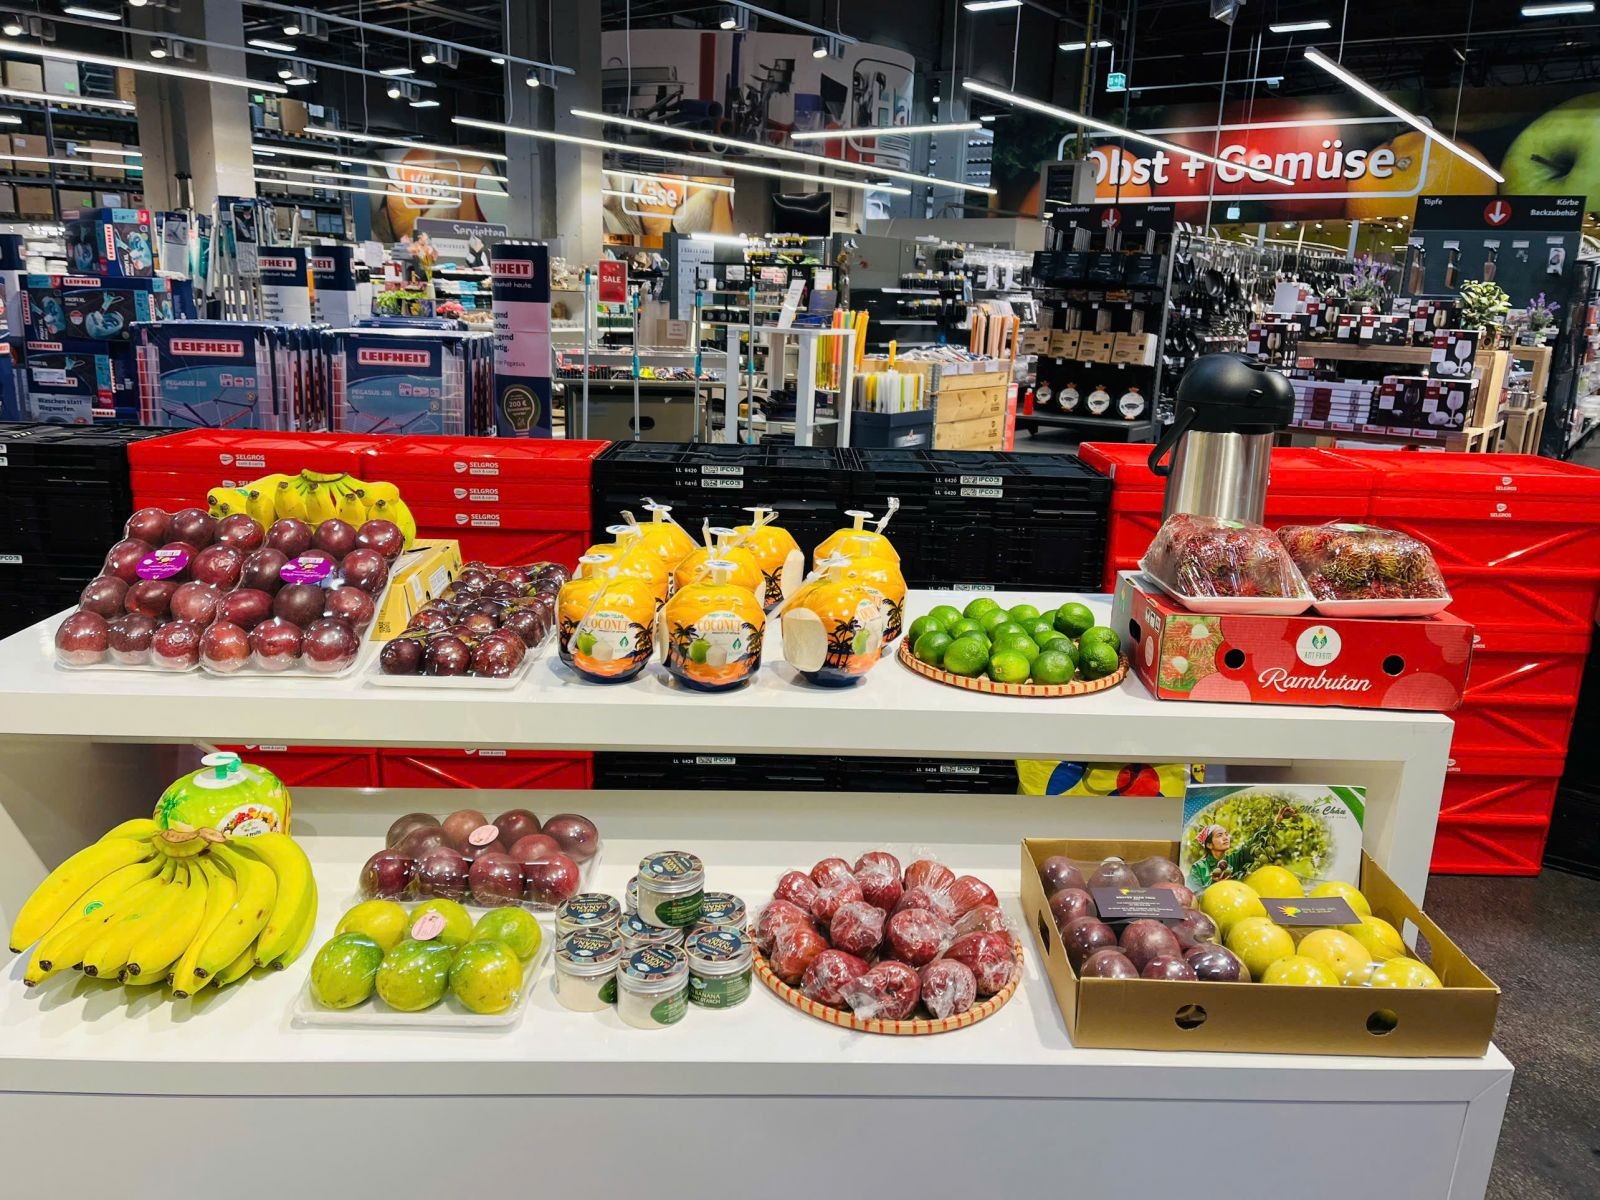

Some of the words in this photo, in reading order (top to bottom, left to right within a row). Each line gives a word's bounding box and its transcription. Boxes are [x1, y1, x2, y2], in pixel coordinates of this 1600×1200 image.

[1085, 148, 1170, 186] Obst
[1181, 152, 1204, 178] +
[1217, 139, 1395, 182] Gemüse
[410, 174, 450, 198] Käse
[633, 178, 678, 208] Käse
[1424, 198, 1443, 206] Töpfe
[1556, 198, 1579, 206] Körbe
[1530, 208, 1578, 216] Backzubehör
[453, 224, 505, 238] Servietten
[602, 275, 622, 283] SALE
[173, 342, 240, 352] LEIFHEIT
[361, 352, 427, 363] LEIFHEIT
[586, 618, 630, 632] COCONUT
[698, 620, 740, 632] COCONUT
[1258, 667, 1372, 692] Rambutan
